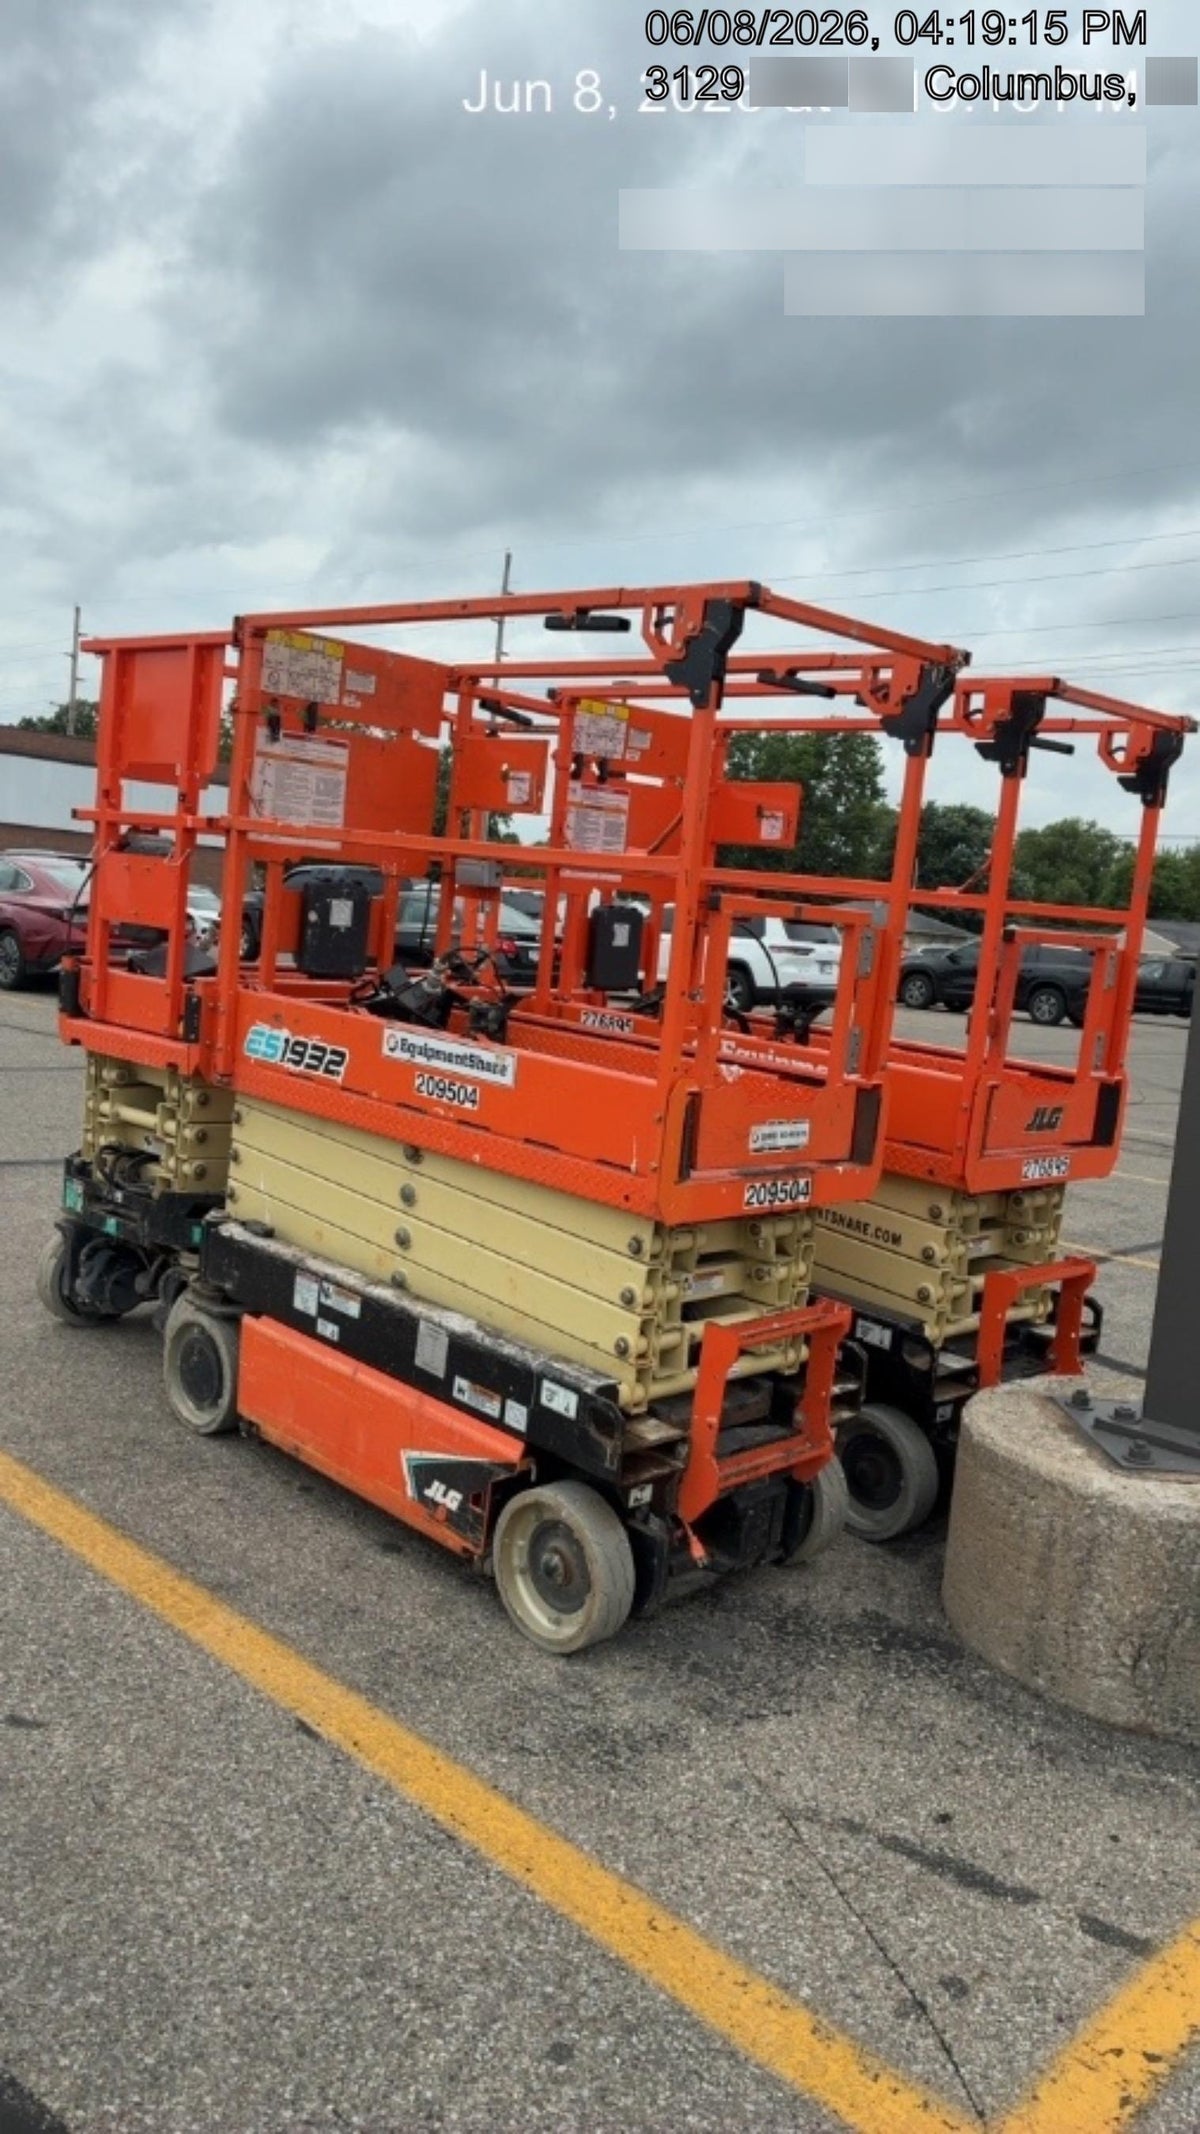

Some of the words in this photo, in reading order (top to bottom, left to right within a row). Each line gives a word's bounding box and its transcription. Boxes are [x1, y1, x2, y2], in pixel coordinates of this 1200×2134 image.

[246, 1028, 347, 1078] ES1932
[400, 1038, 508, 1077] EquipmentShare
[416, 1073, 478, 1107] 209504
[1024, 1106, 1063, 1131] JLG
[745, 1180, 810, 1206] 209504
[424, 1479, 463, 1511] JLG
